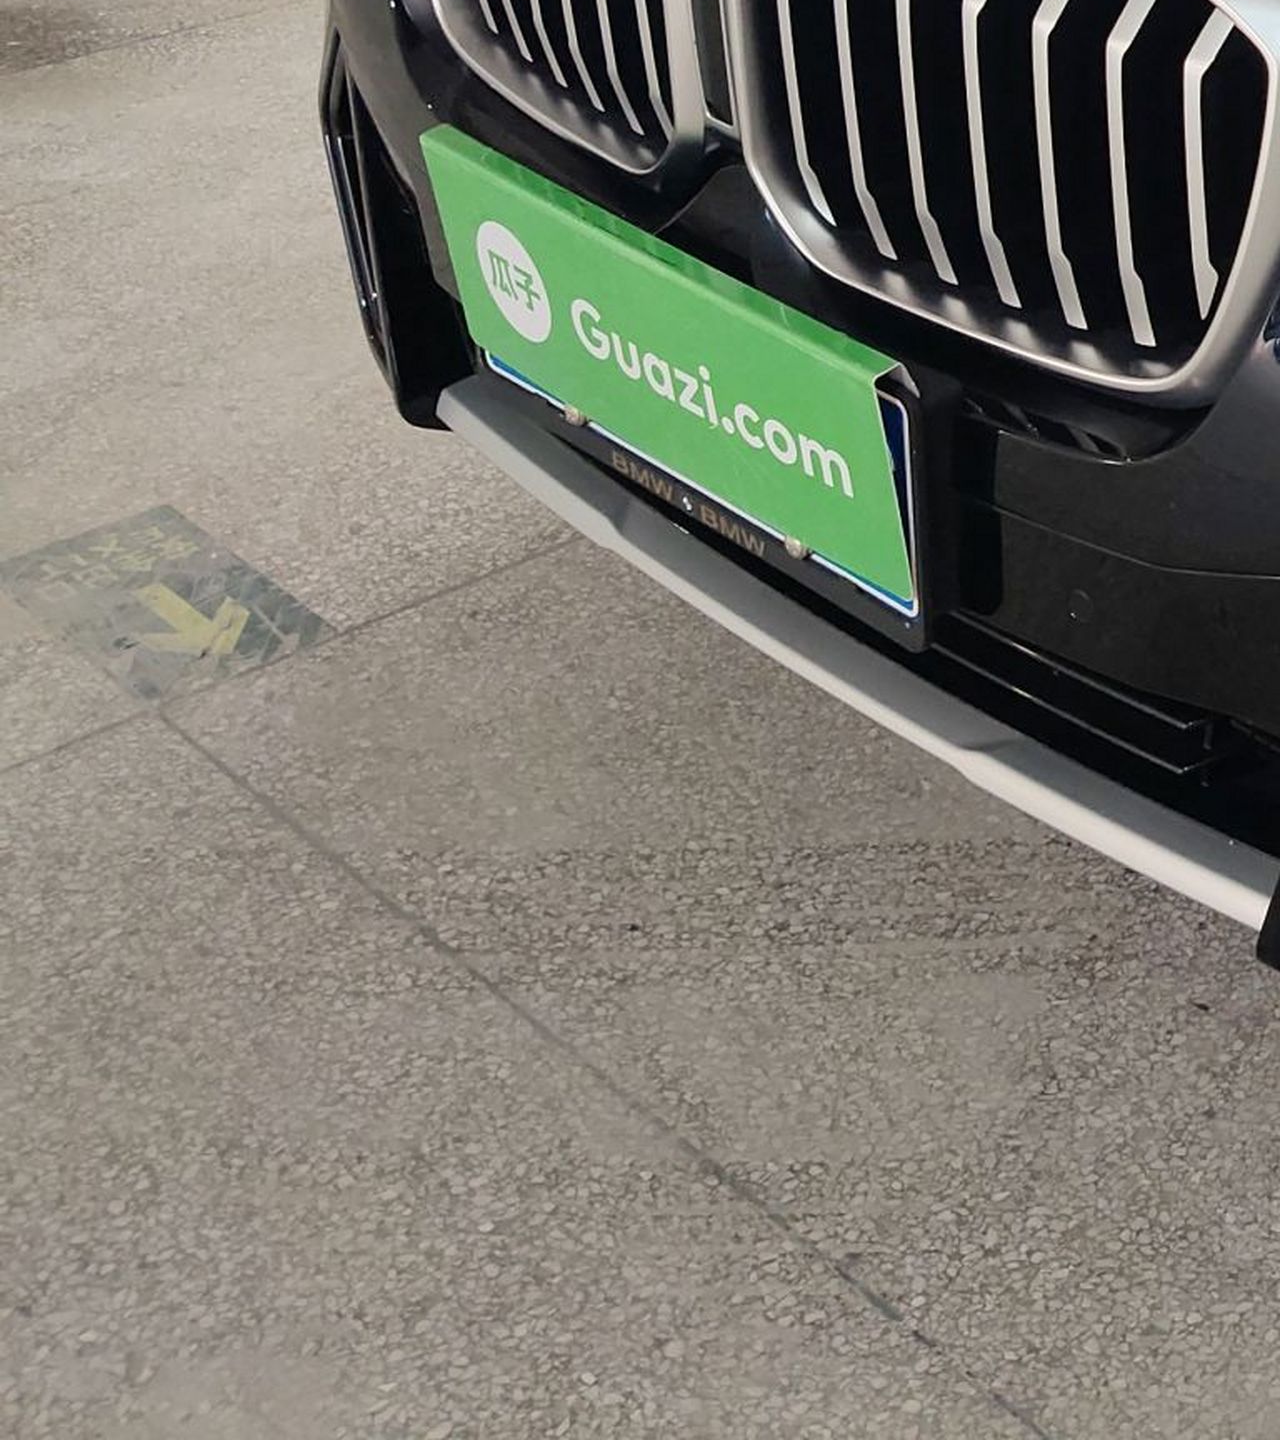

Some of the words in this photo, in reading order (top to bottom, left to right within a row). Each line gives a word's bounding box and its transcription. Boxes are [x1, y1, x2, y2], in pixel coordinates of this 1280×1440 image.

[488, 248, 542, 313] 瓜子
[570, 298, 854, 498] Guazi.com
[611, 450, 675, 502] BMW
[700, 505, 767, 558] BMW
